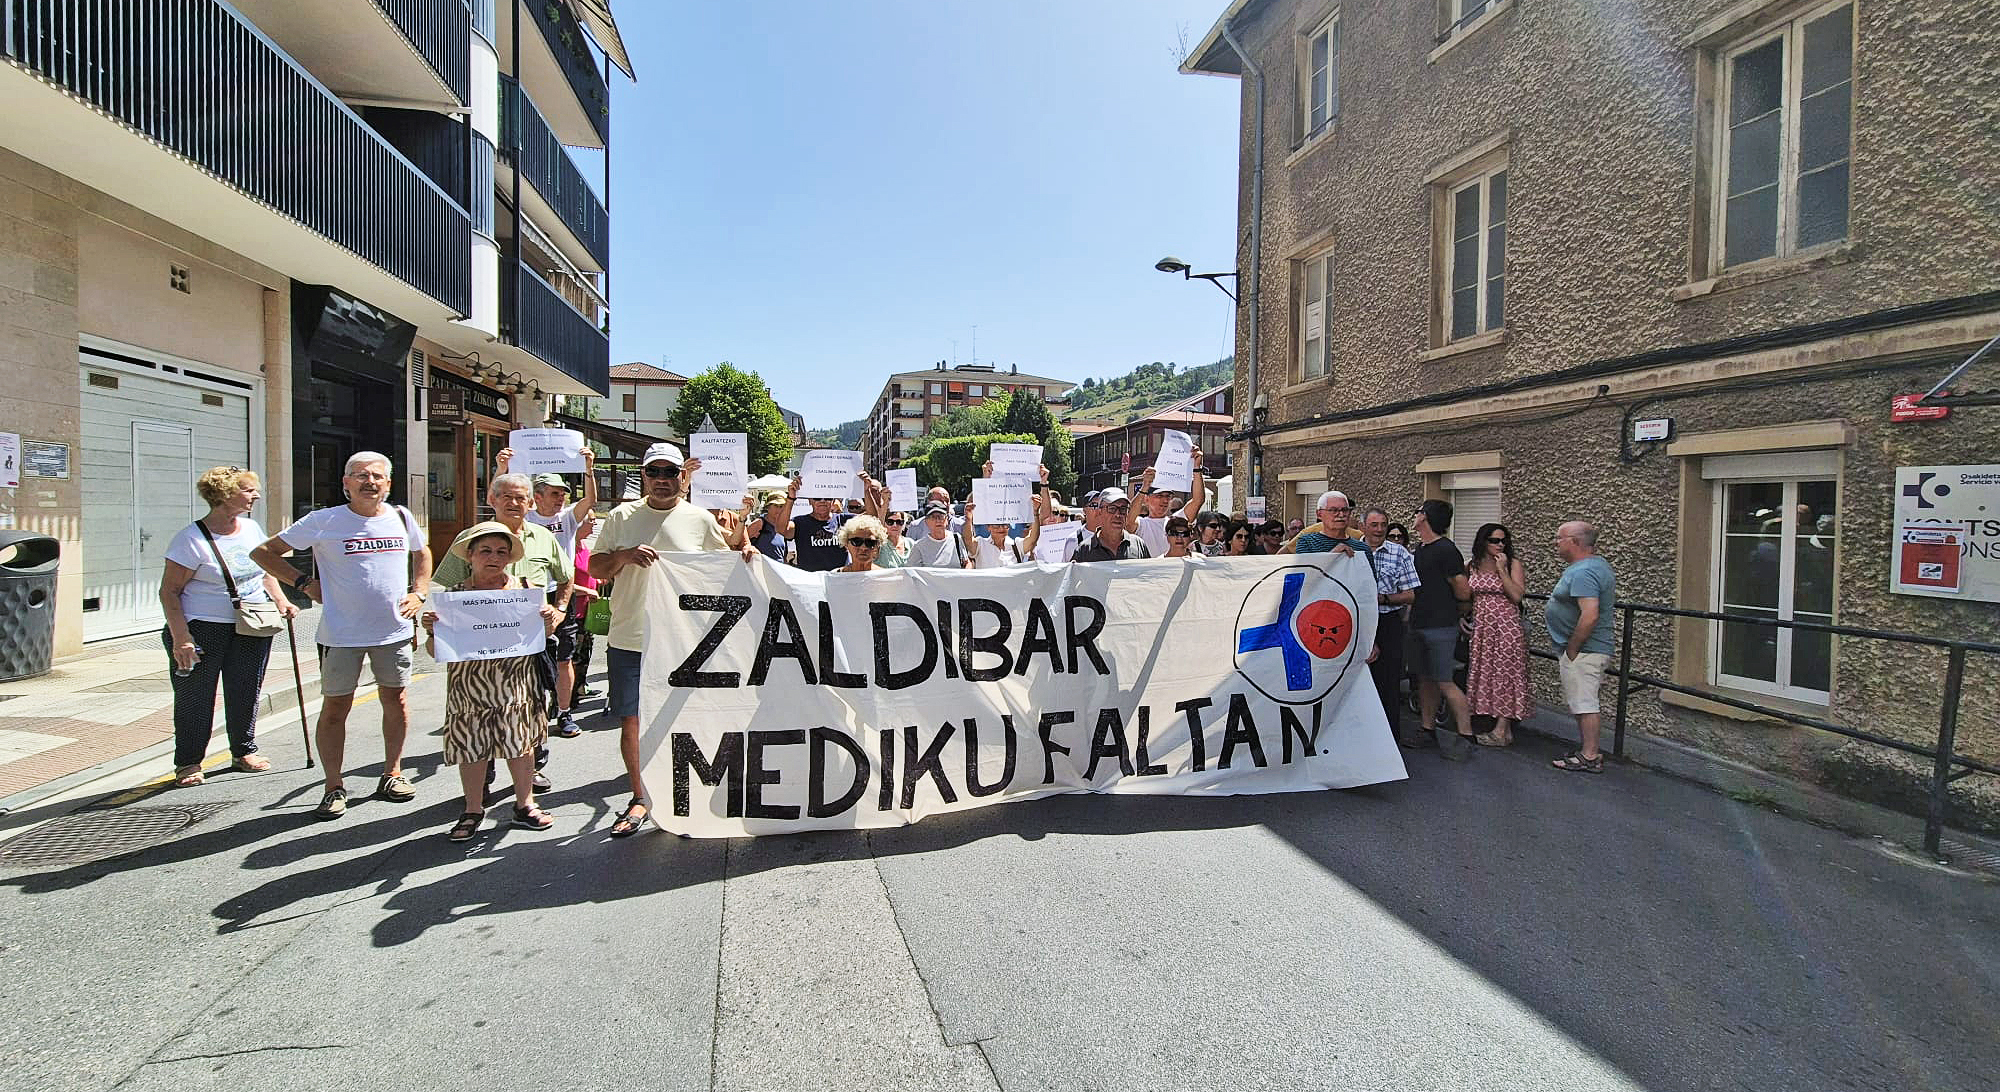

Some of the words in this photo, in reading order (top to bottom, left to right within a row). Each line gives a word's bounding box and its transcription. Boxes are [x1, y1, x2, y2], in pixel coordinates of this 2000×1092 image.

[356, 540, 404, 550] ZALDIBAR
[667, 593, 1109, 690] ZALDIBAR
[671, 715, 1018, 820] MEDIKU
